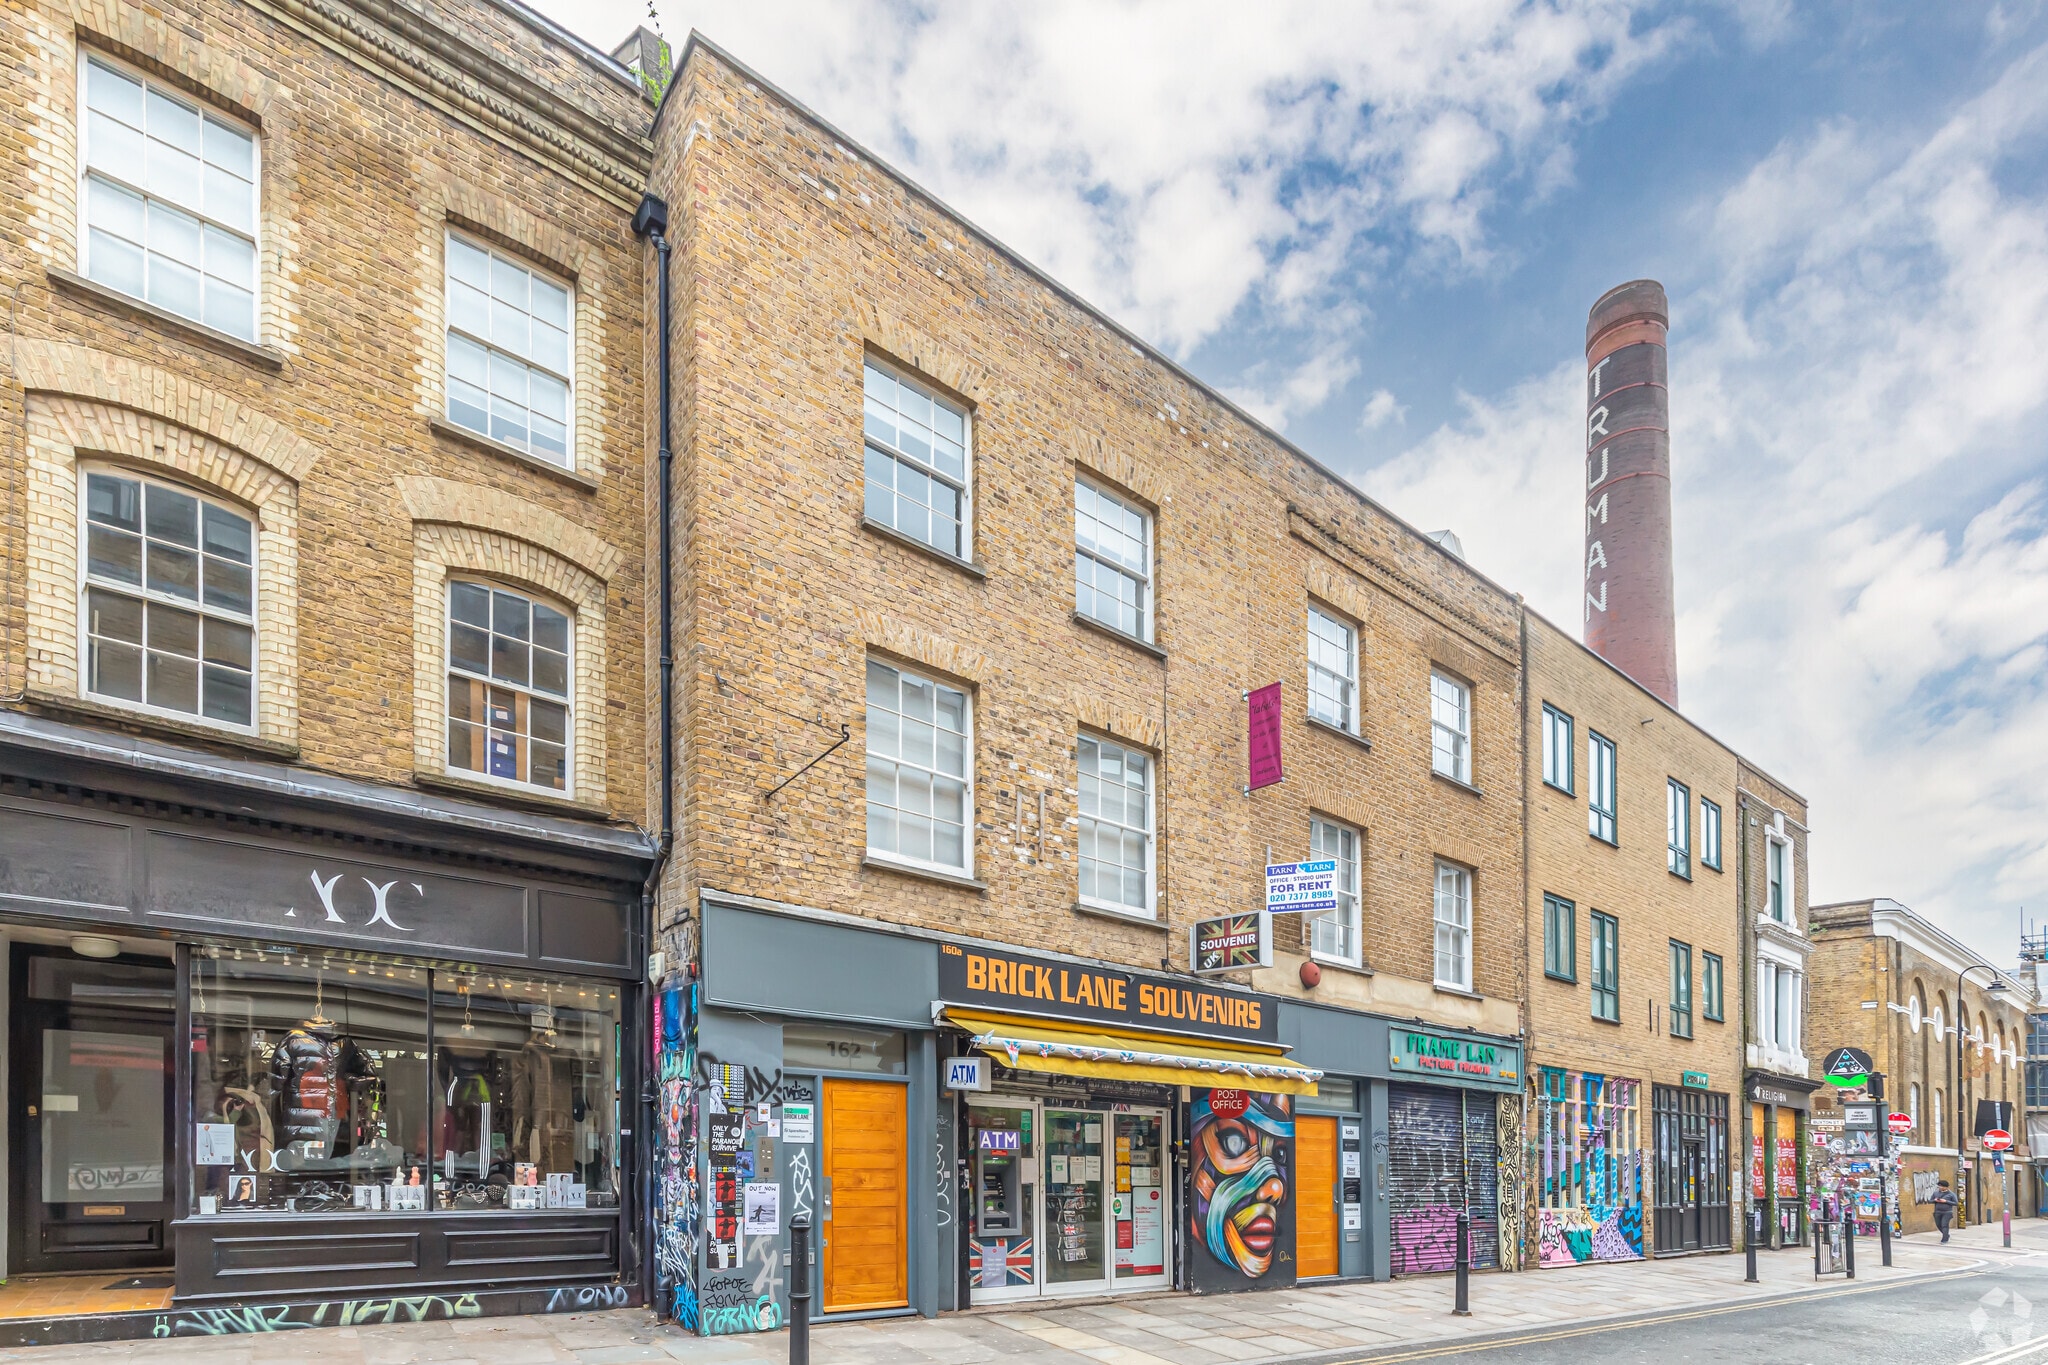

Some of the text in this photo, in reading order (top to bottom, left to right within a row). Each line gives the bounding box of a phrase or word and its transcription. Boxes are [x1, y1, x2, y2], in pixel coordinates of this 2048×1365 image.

[1586, 357, 1610, 622] TRUMAN
[1270, 866, 1293, 875] TARN
[1308, 863, 1332, 872] TARN
[1293, 874, 1314, 882] STUDIO
[1270, 880, 1333, 894] FOR RENT
[1270, 890, 1333, 903] 020 7377 8989
[1270, 902, 1334, 911] www.tarn-tarn.co.uk
[1200, 933, 1256, 951] SOUVENIR
[941, 944, 963, 956] 160a
[1203, 951, 1221, 969] UK
[966, 954, 1262, 1030] BRICK LANE SOUVENIRS
[827, 1041, 861, 1059] 162
[1407, 1033, 1460, 1060] FRAME
[1419, 1055, 1456, 1071] PICTURE
[951, 1065, 975, 1084] ATM
[1217, 1089, 1239, 1099] POST
[1212, 1099, 1243, 1110] OFFICE
[712, 1125, 729, 1133] ONLY
[712, 1138, 739, 1146] PARANO
[980, 1131, 1017, 1149] ATM
[545, 1285, 629, 1313] MONO
